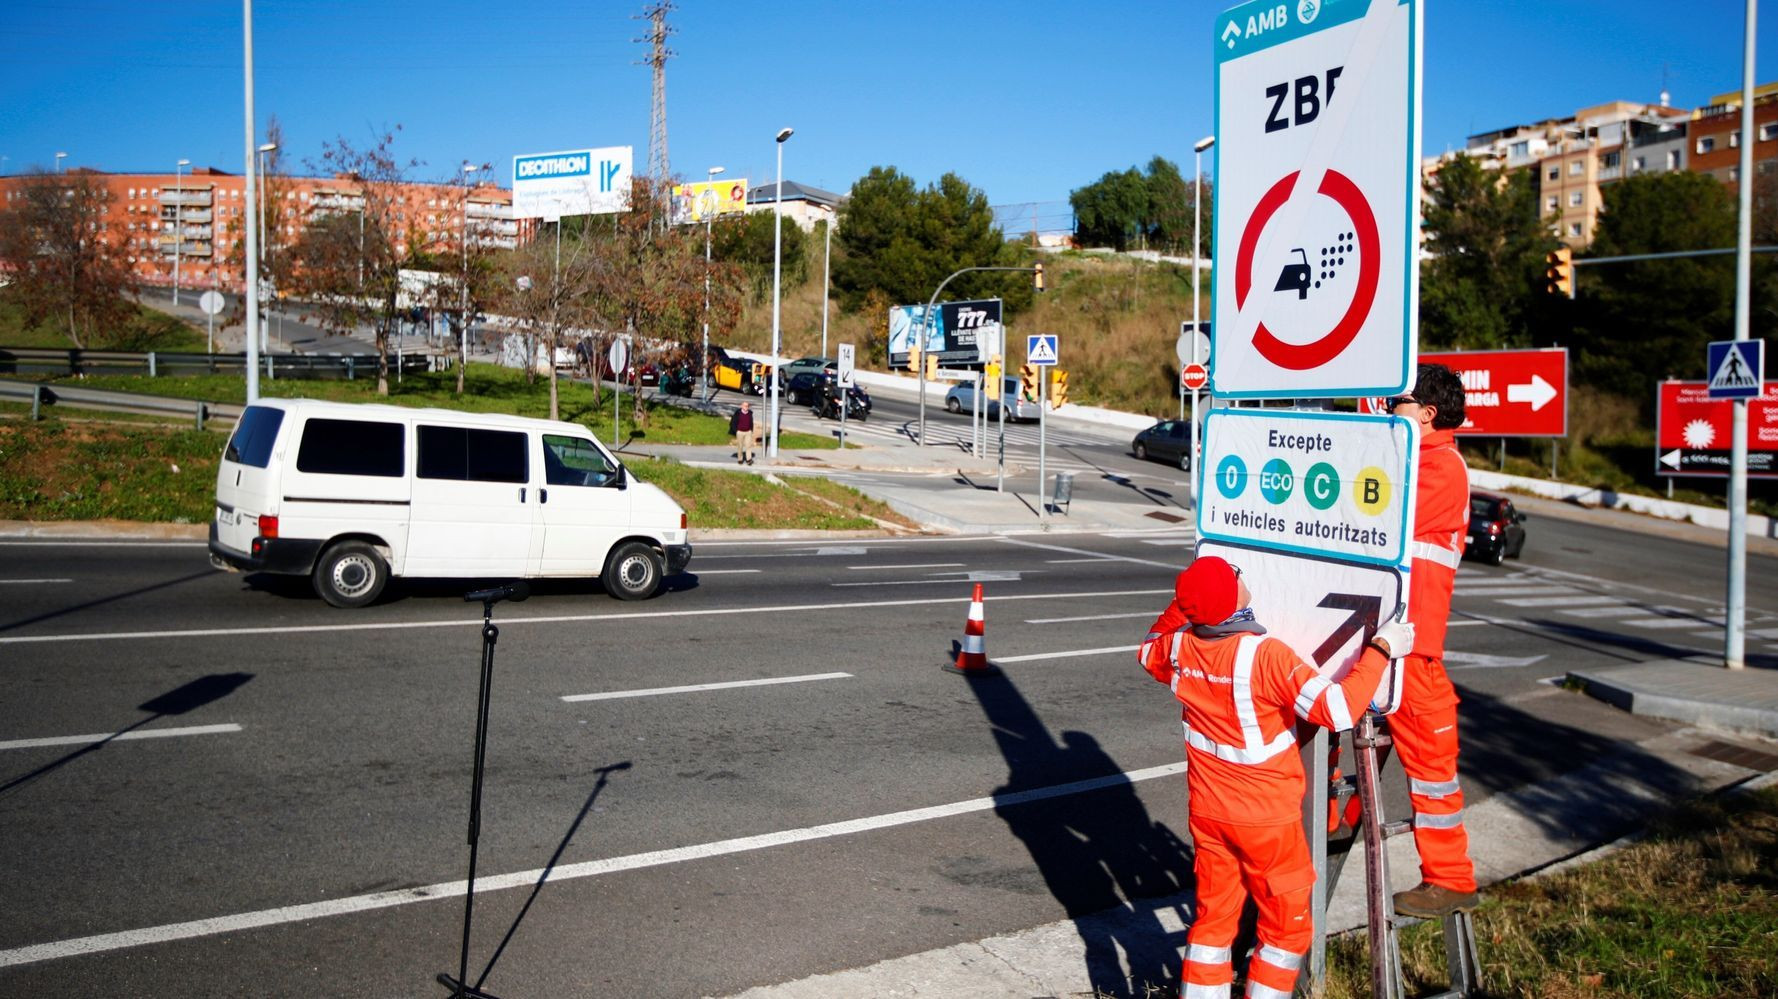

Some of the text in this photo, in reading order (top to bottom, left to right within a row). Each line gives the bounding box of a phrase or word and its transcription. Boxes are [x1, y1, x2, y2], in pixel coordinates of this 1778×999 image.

[1245, 4, 1288, 39] AMB
[518, 156, 587, 177] DECATHLON
[843, 348, 850, 361] 14
[1184, 372, 1205, 380] STOP
[1268, 429, 1332, 454] Excepte
[1225, 465, 1380, 505] 0 ECO C B
[1211, 505, 1388, 547] i vehicles autoritzats
